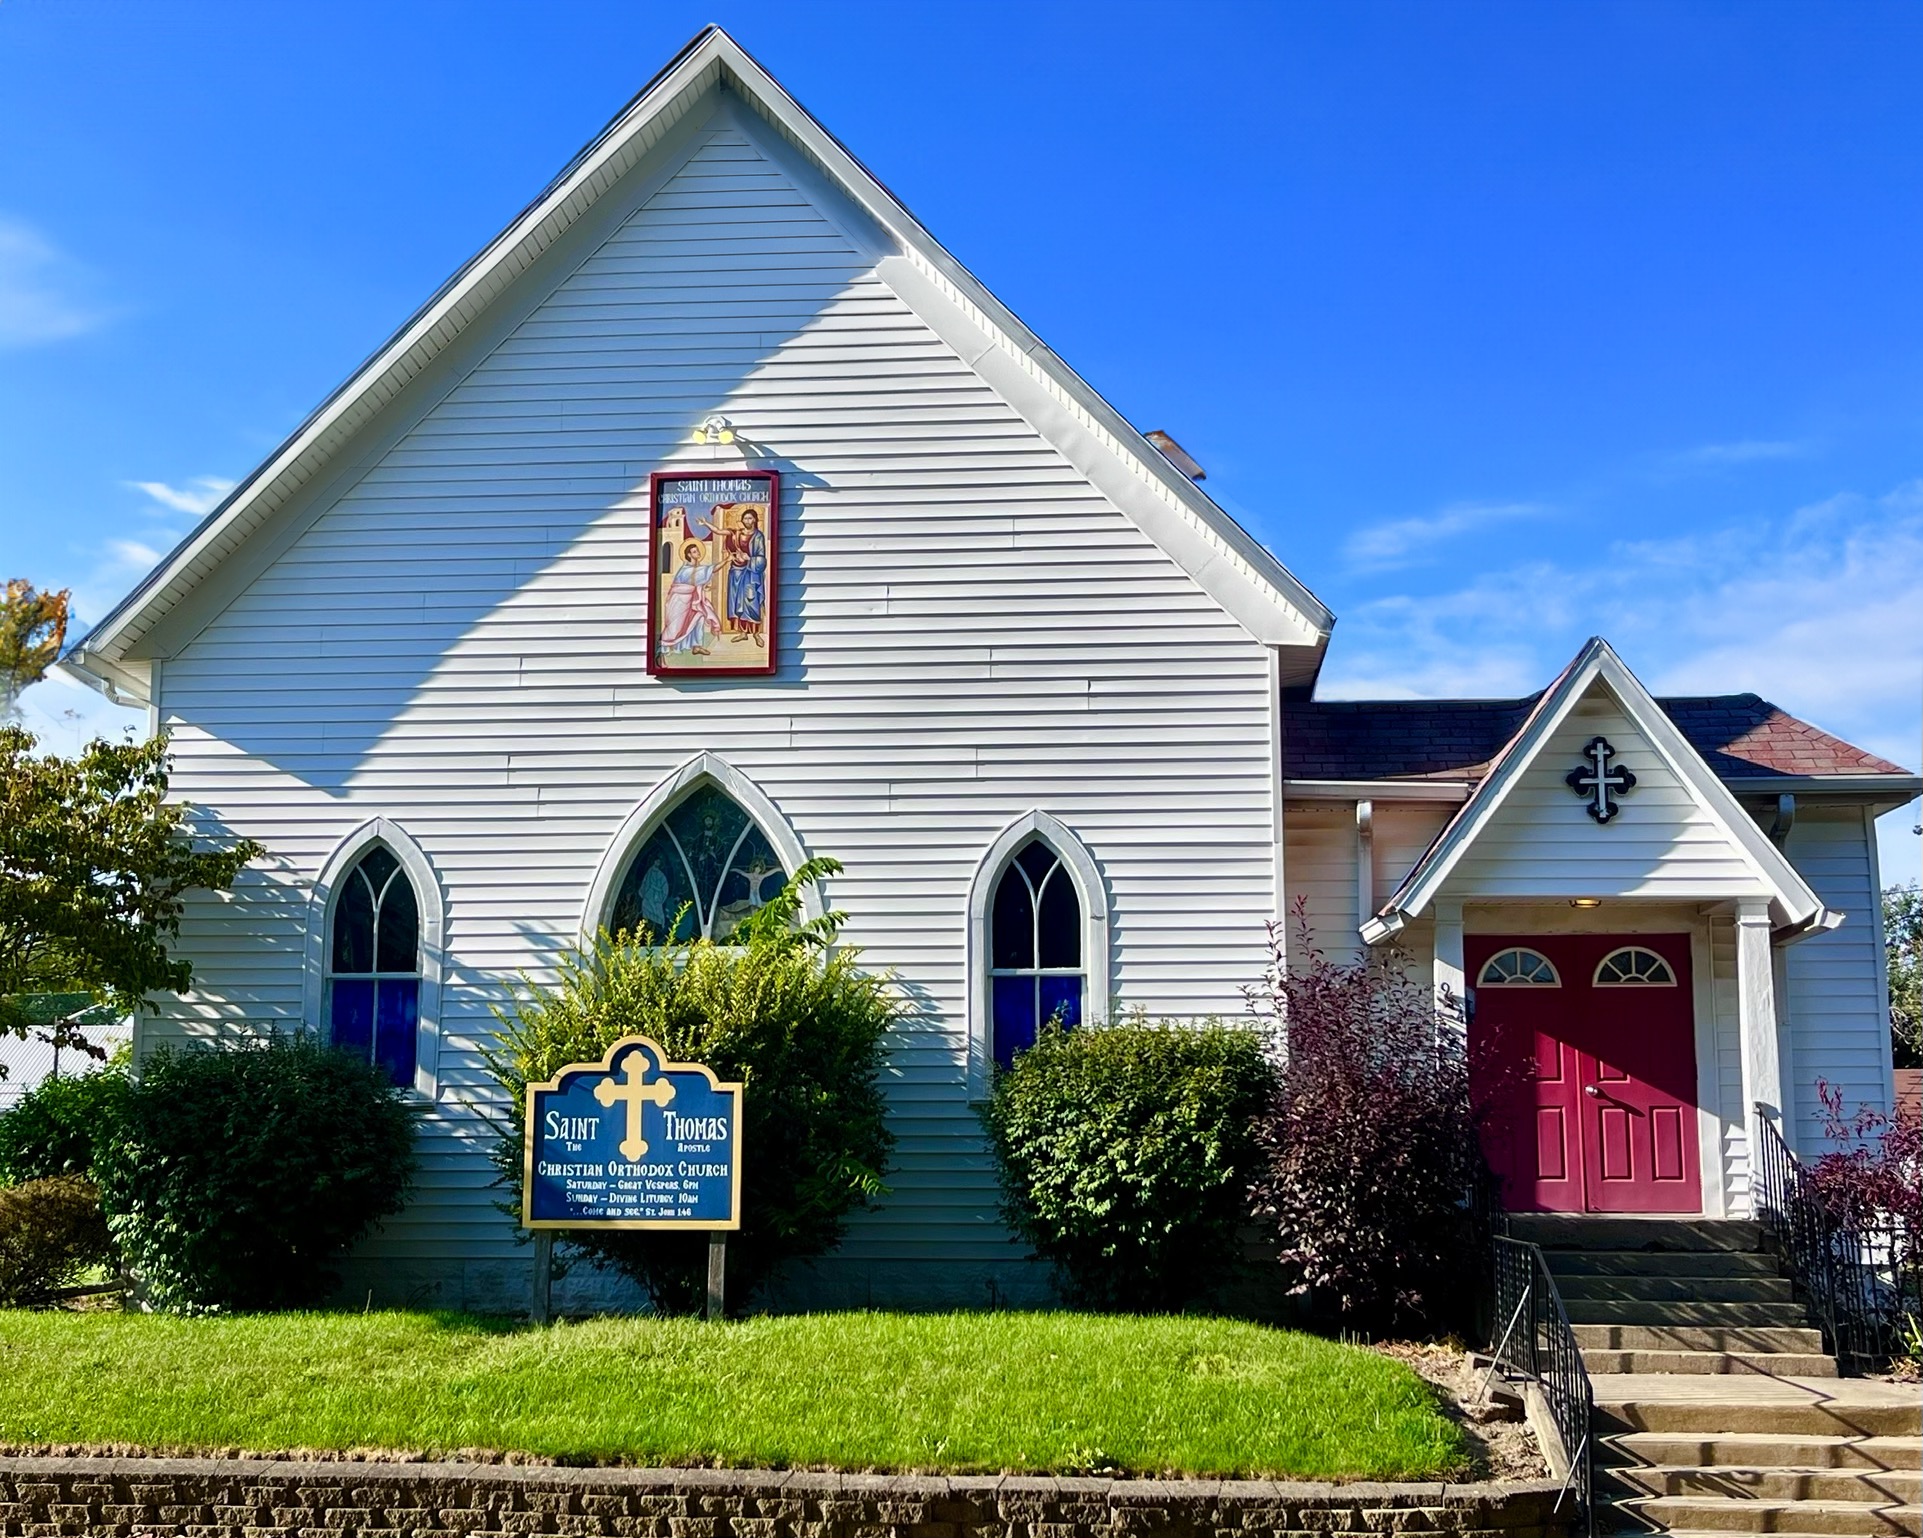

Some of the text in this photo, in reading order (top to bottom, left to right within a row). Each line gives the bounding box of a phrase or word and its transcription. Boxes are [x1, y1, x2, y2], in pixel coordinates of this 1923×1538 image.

[677, 479, 752, 492] SAINT THOMAS
[739, 491, 769, 502] CHURCH
[544, 1110, 728, 1141] SAINT THOMAS
[538, 1160, 728, 1177] CHRISTIAN ORTHODOX CHURCH
[566, 1179, 607, 1190] SATURDAY
